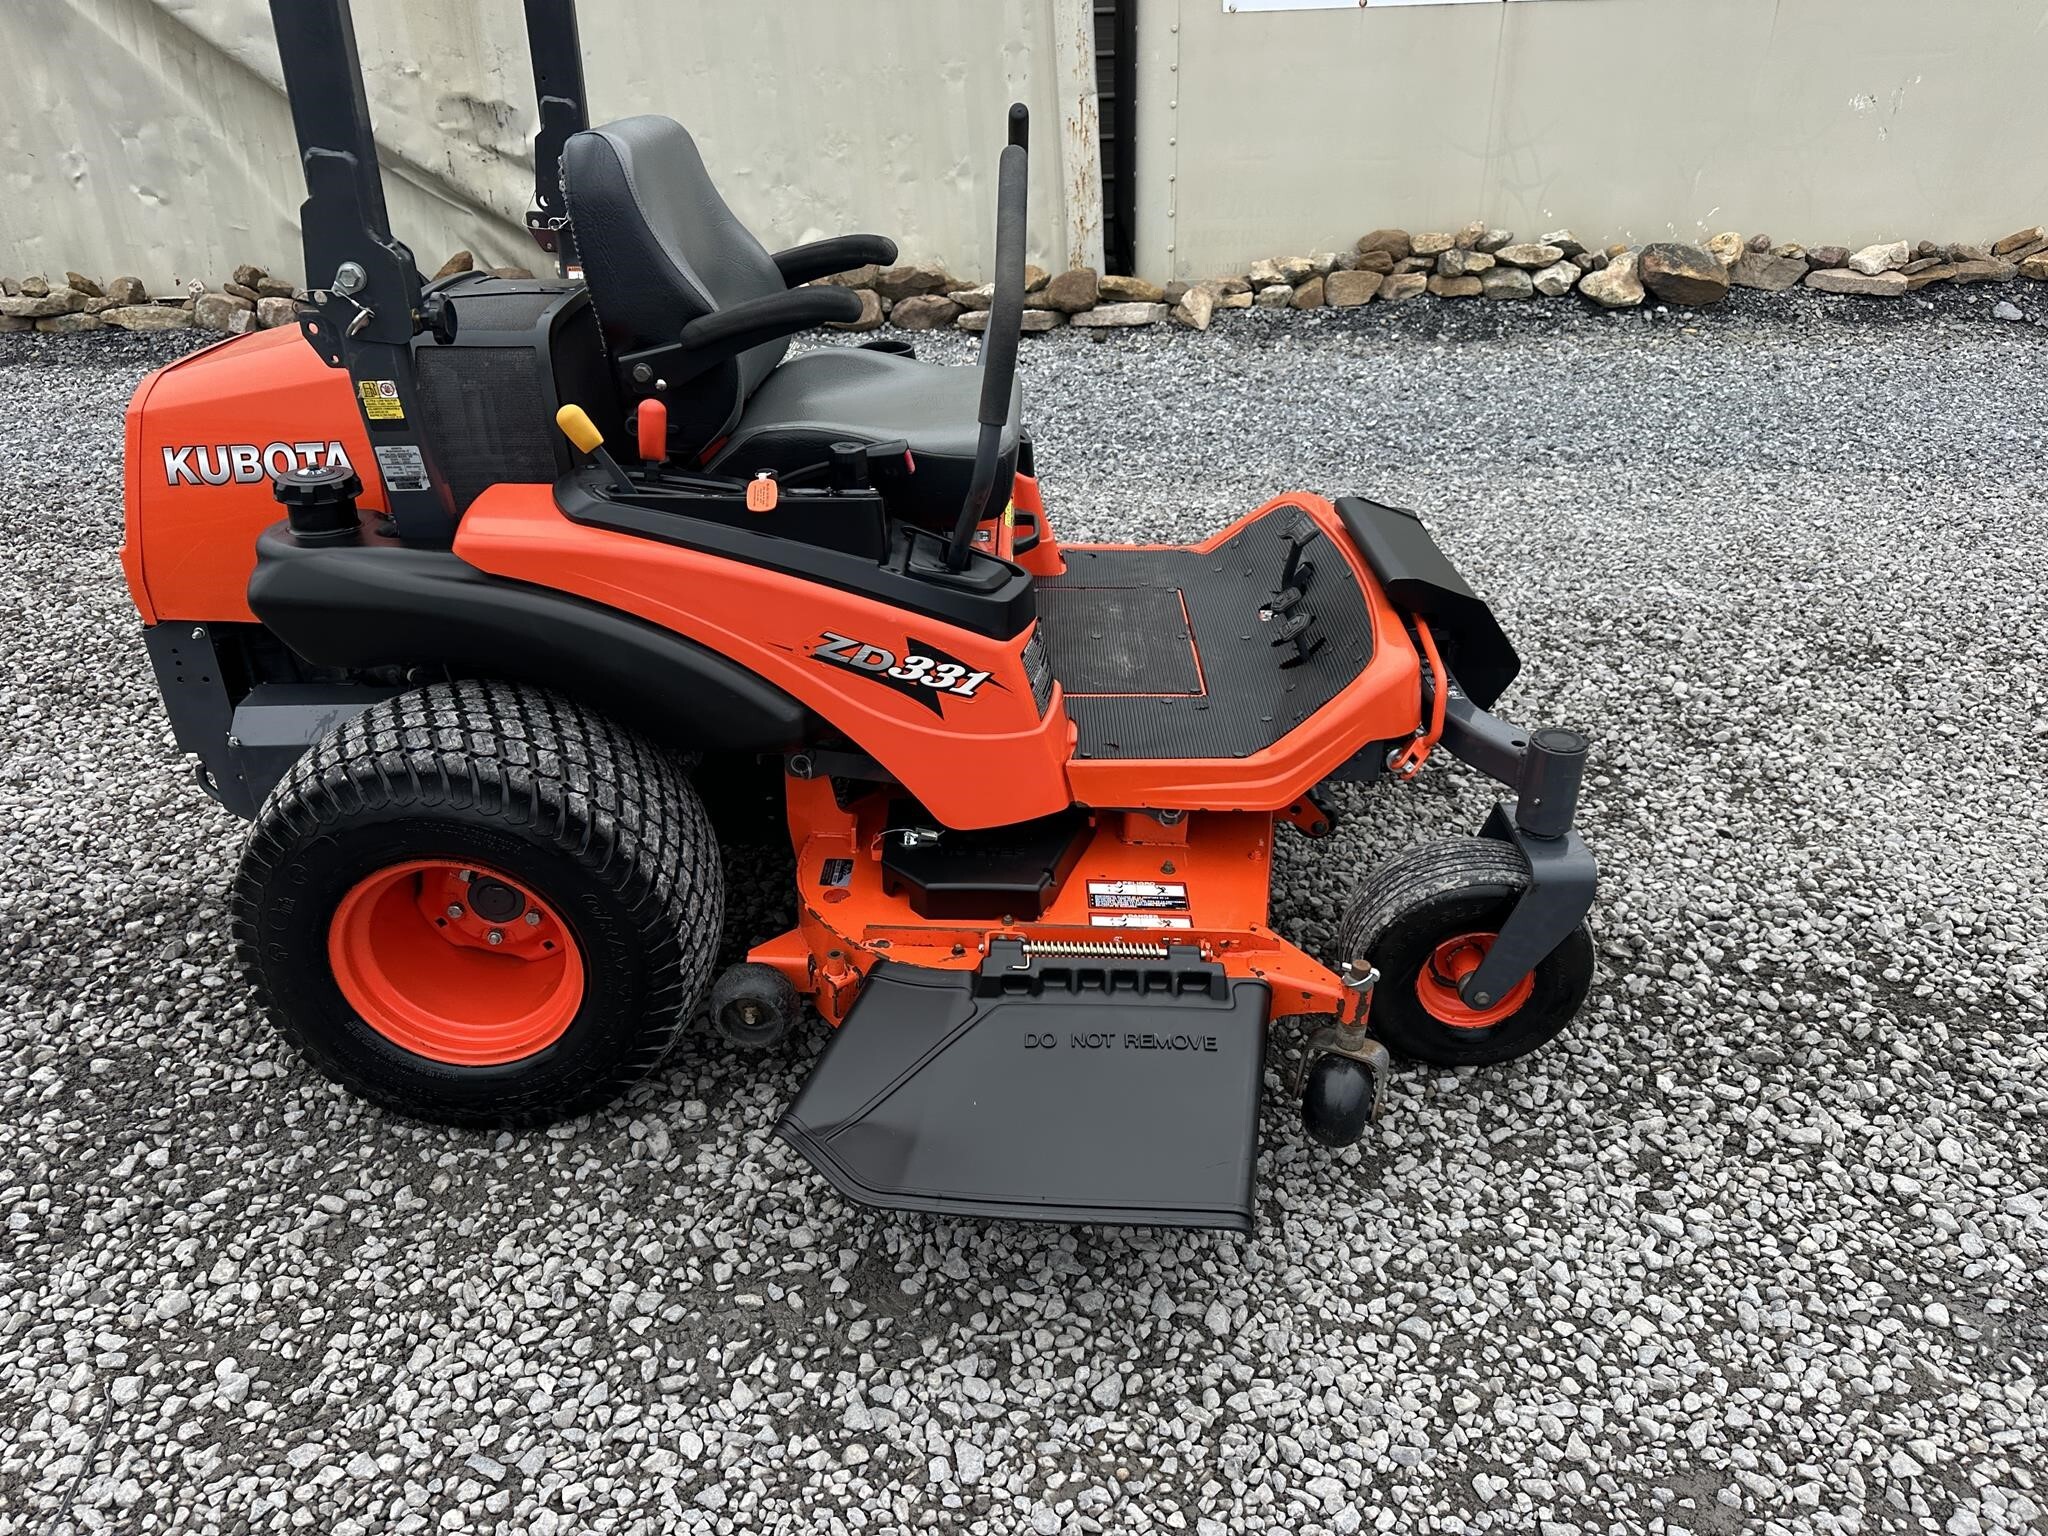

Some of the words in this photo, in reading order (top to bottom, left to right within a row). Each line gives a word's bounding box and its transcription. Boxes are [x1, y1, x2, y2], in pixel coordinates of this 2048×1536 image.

[162, 441, 354, 486] KUBOTA
[811, 630, 993, 697] ZD331
[1024, 1033, 1057, 1049] DO
[1071, 1033, 1115, 1049] NOT
[1124, 1033, 1218, 1052] REMOVE
